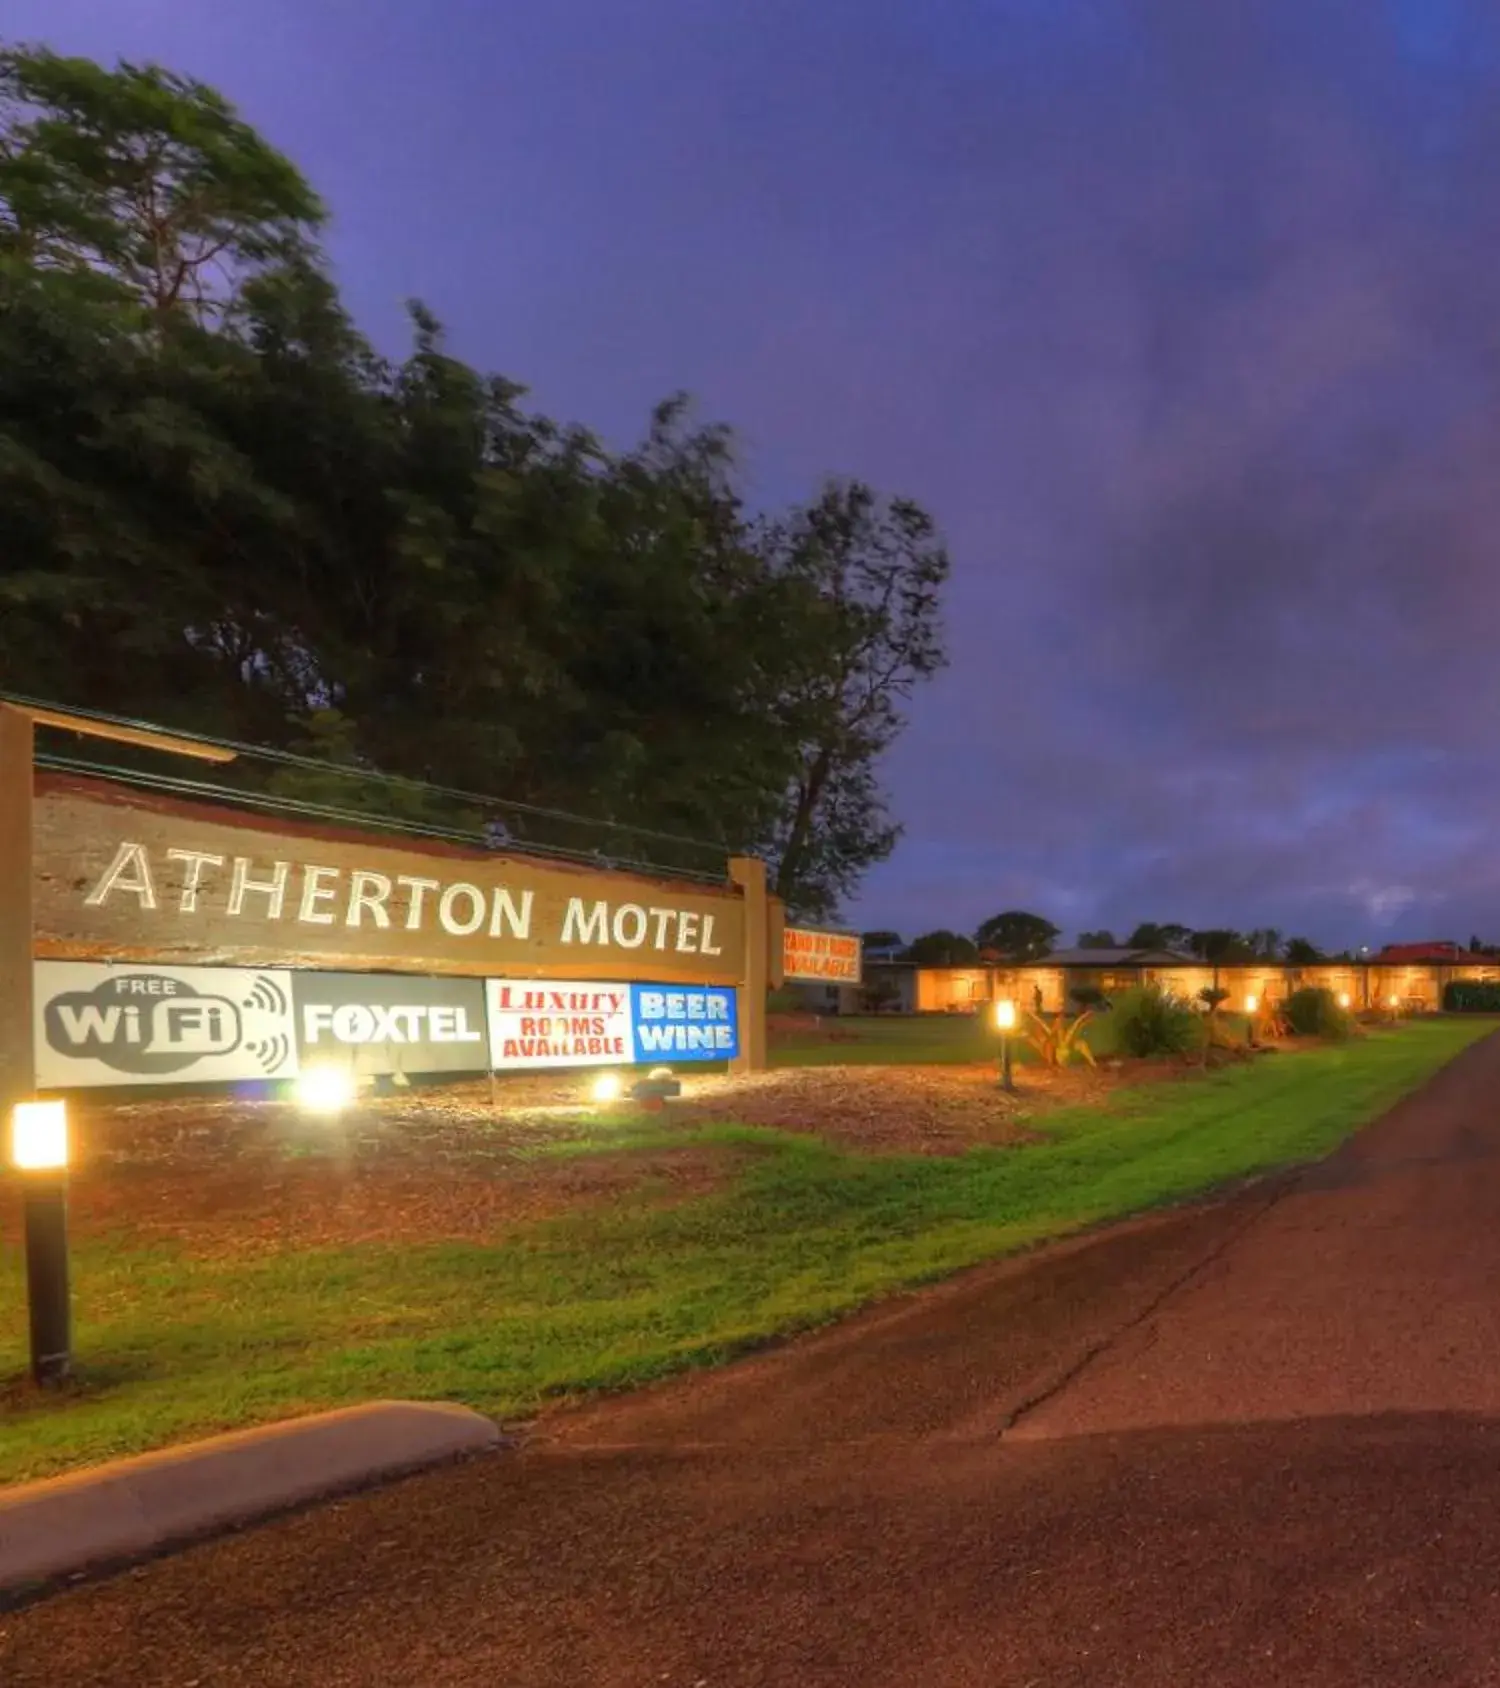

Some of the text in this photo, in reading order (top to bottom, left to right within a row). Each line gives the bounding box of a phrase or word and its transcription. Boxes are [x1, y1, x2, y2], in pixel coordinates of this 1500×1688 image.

[84, 841, 721, 956] ATHERTON MOTEL
[115, 978, 178, 996] FREE
[639, 991, 728, 1019] BEER
[303, 1003, 481, 1043] FOXTEL
[520, 1016, 605, 1037] ROOMS
[637, 1023, 734, 1051] WINE
[503, 1037, 624, 1058] AVAILABLE
